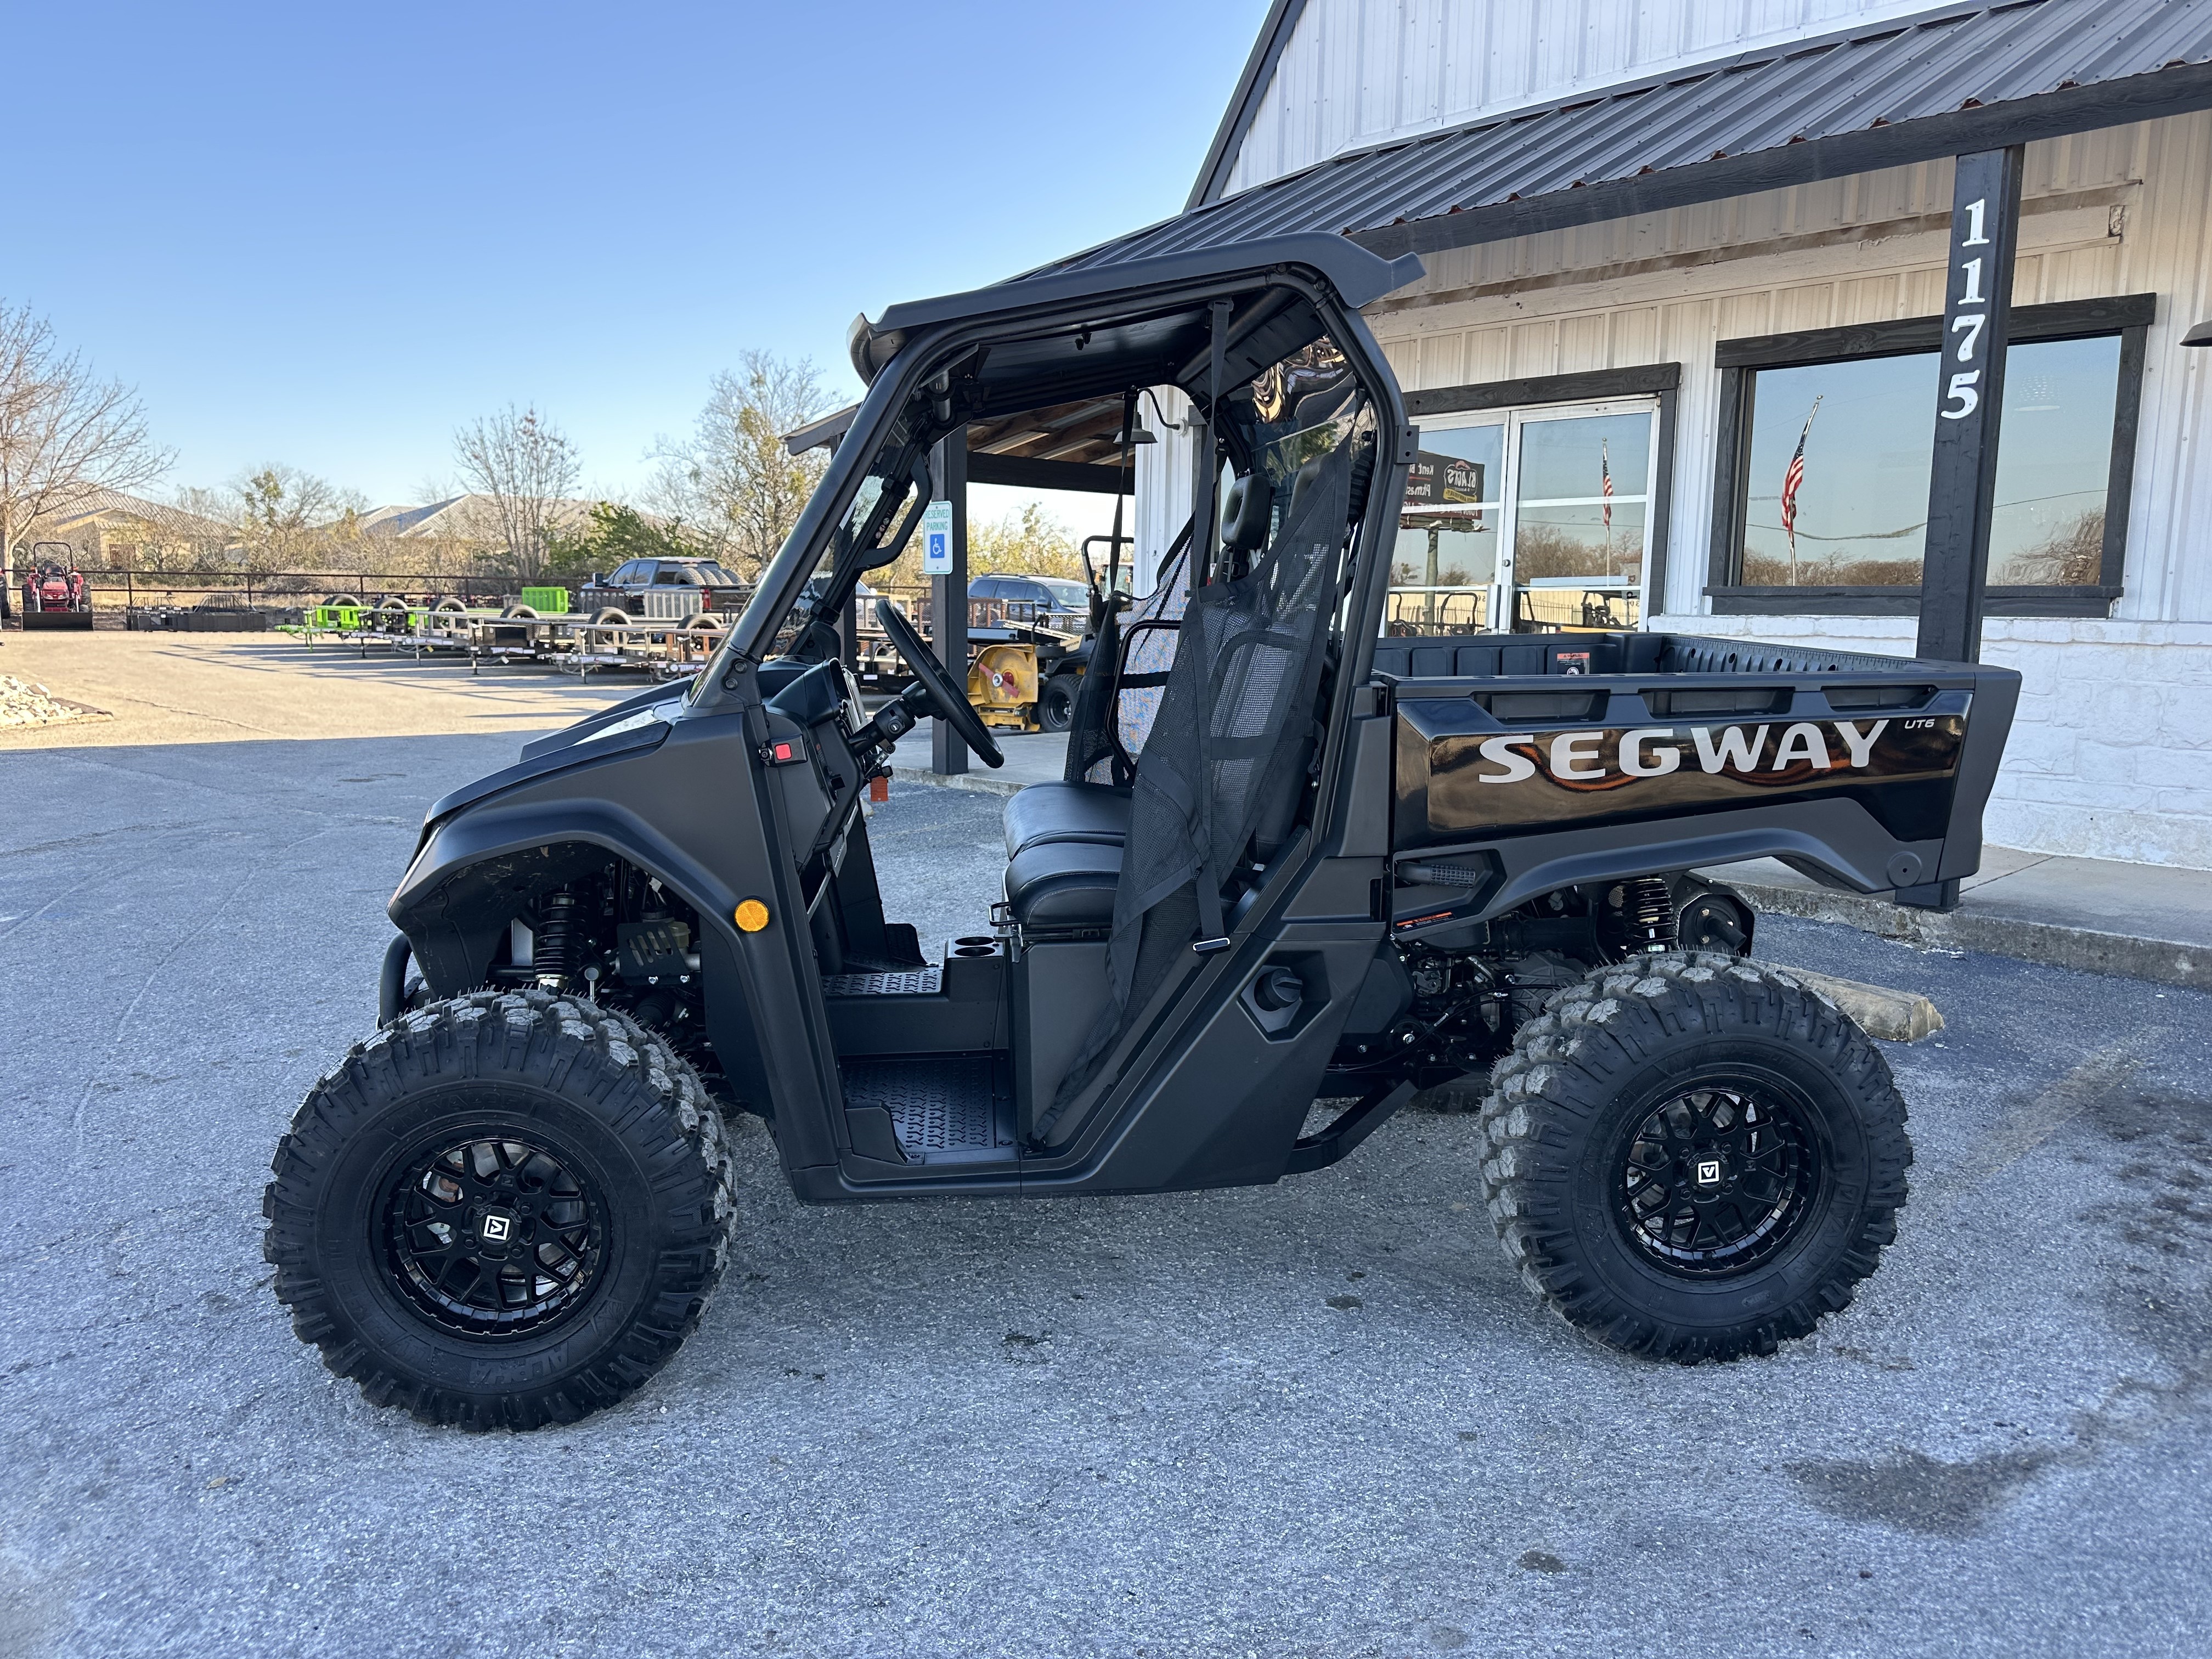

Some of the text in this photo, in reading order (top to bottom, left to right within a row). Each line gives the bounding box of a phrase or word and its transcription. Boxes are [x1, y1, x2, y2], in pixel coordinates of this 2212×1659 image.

[1940, 199, 1990, 420] 1175
[925, 509, 949, 518] RESERVED
[927, 521, 948, 531] PARKING
[1479, 719, 1936, 783] SEGWAY UT6
